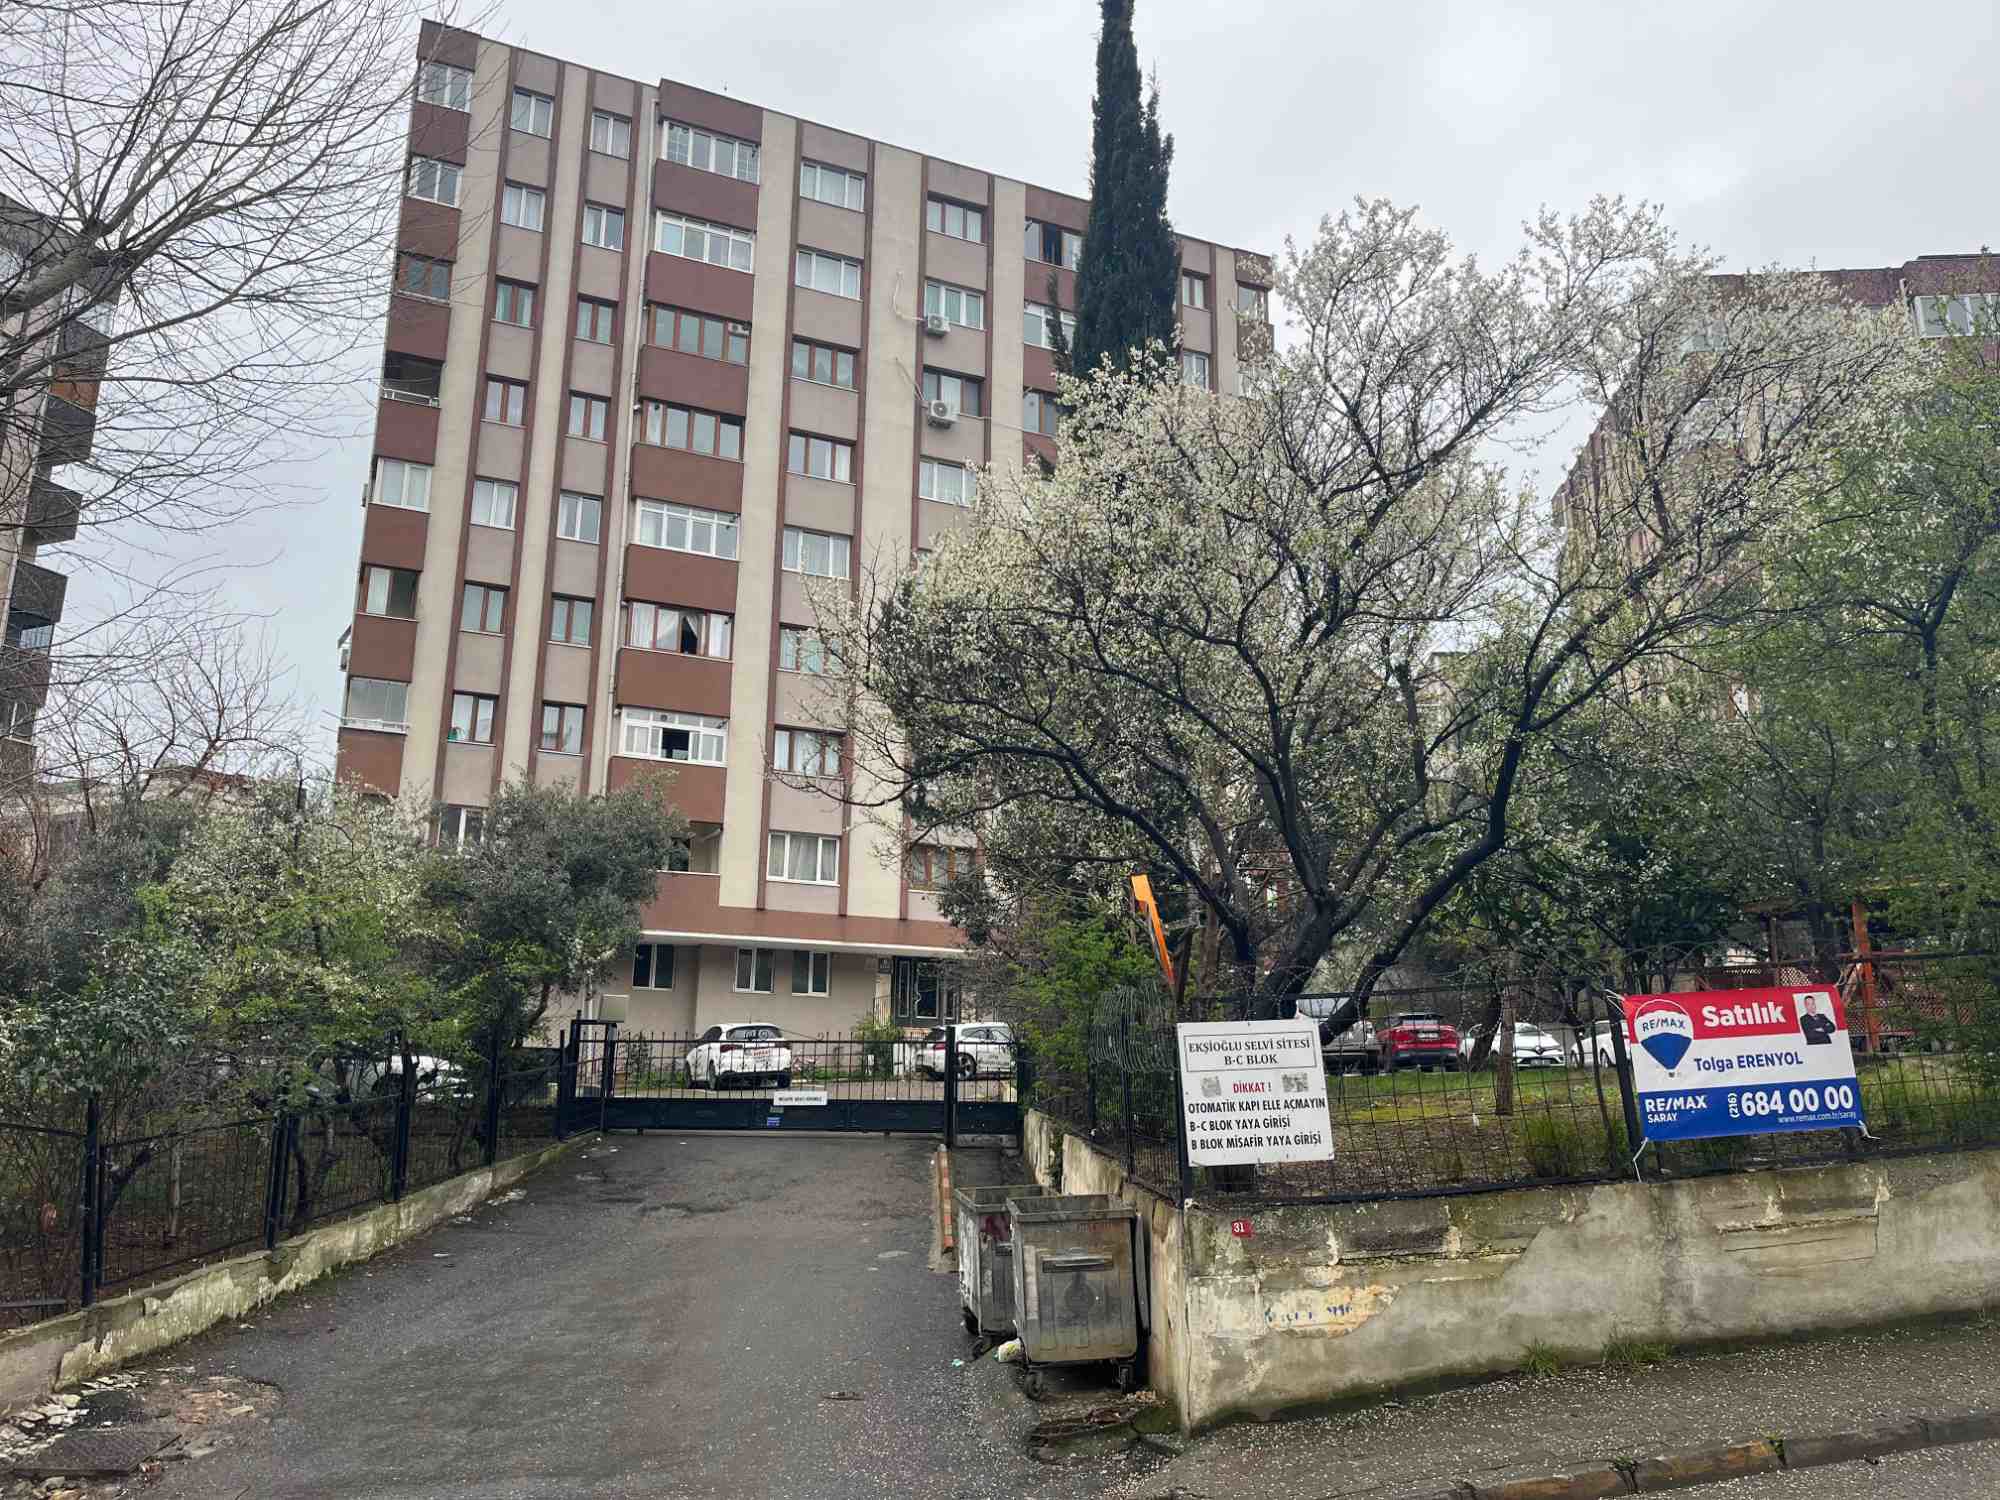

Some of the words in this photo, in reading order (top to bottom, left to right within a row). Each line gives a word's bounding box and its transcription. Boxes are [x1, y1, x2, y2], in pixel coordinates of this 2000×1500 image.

[1702, 1002, 1786, 1027] Satılık
[1642, 1017, 1686, 1032] RE/MAX
[1189, 1039, 1242, 1054] EKŞİOĞLU
[1244, 1038, 1274, 1050] SELVİ
[1276, 1037, 1310, 1049] SİTESİ
[1246, 1054, 1278, 1064] BLOK
[1694, 1056, 1734, 1072] Tolga
[1738, 1051, 1803, 1069] ERENYOL
[1232, 1082, 1265, 1094] DİKKAT
[1188, 1100, 1235, 1114] OTOMATİK
[1238, 1101, 1259, 1112] KAPI
[1263, 1100, 1281, 1110] ELLE
[1284, 1098, 1326, 1112] AÇMAYIN
[1645, 1095, 1707, 1112] RE/MAX
[1728, 1093, 1739, 1118] (216)
[1741, 1090, 1784, 1116] 684
[1789, 1088, 1820, 1112] 00
[1825, 1085, 1853, 1110] 00
[1190, 1120, 1207, 1131] B-C
[1210, 1120, 1232, 1130] BLOK
[1235, 1118, 1260, 1129] YAYA
[1263, 1115, 1290, 1129] GİRİŞİ
[1648, 1113, 1678, 1123] SARAY
[1192, 1140, 1197, 1150] B
[1200, 1138, 1223, 1149] BLOK
[1226, 1134, 1263, 1148] MİSAFİR
[1267, 1136, 1291, 1146] YAYA
[1294, 1131, 1321, 1146] GİRİŞİ
[1234, 1222, 1244, 1233] 31
